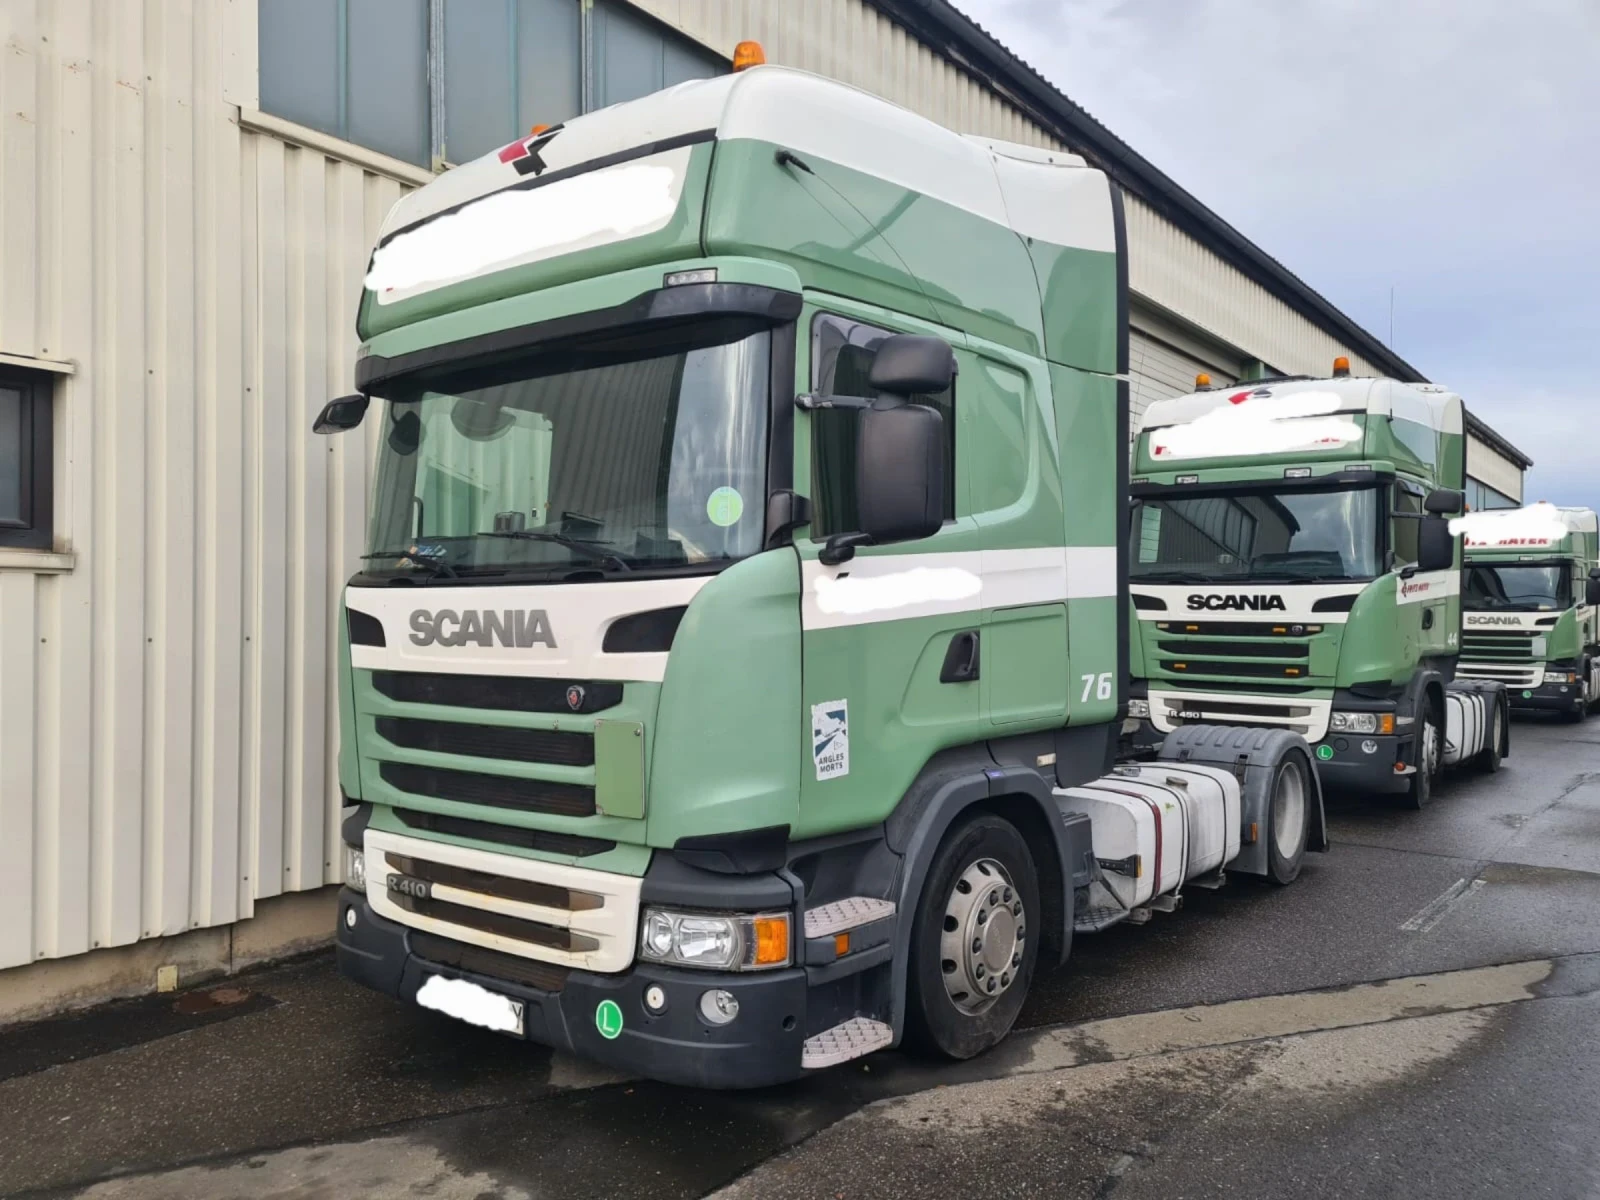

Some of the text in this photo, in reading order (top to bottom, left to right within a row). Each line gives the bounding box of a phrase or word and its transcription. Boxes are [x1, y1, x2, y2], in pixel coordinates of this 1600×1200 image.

[1186, 594, 1286, 611] SCANIA
[408, 609, 558, 648] SCANIA
[1466, 616, 1522, 625] SCANIA
[1081, 672, 1112, 702] 76
[819, 753, 844, 765] ANGLES
[820, 762, 843, 773] MORTS
[387, 876, 426, 898] R 410
[603, 1007, 614, 1032] L
